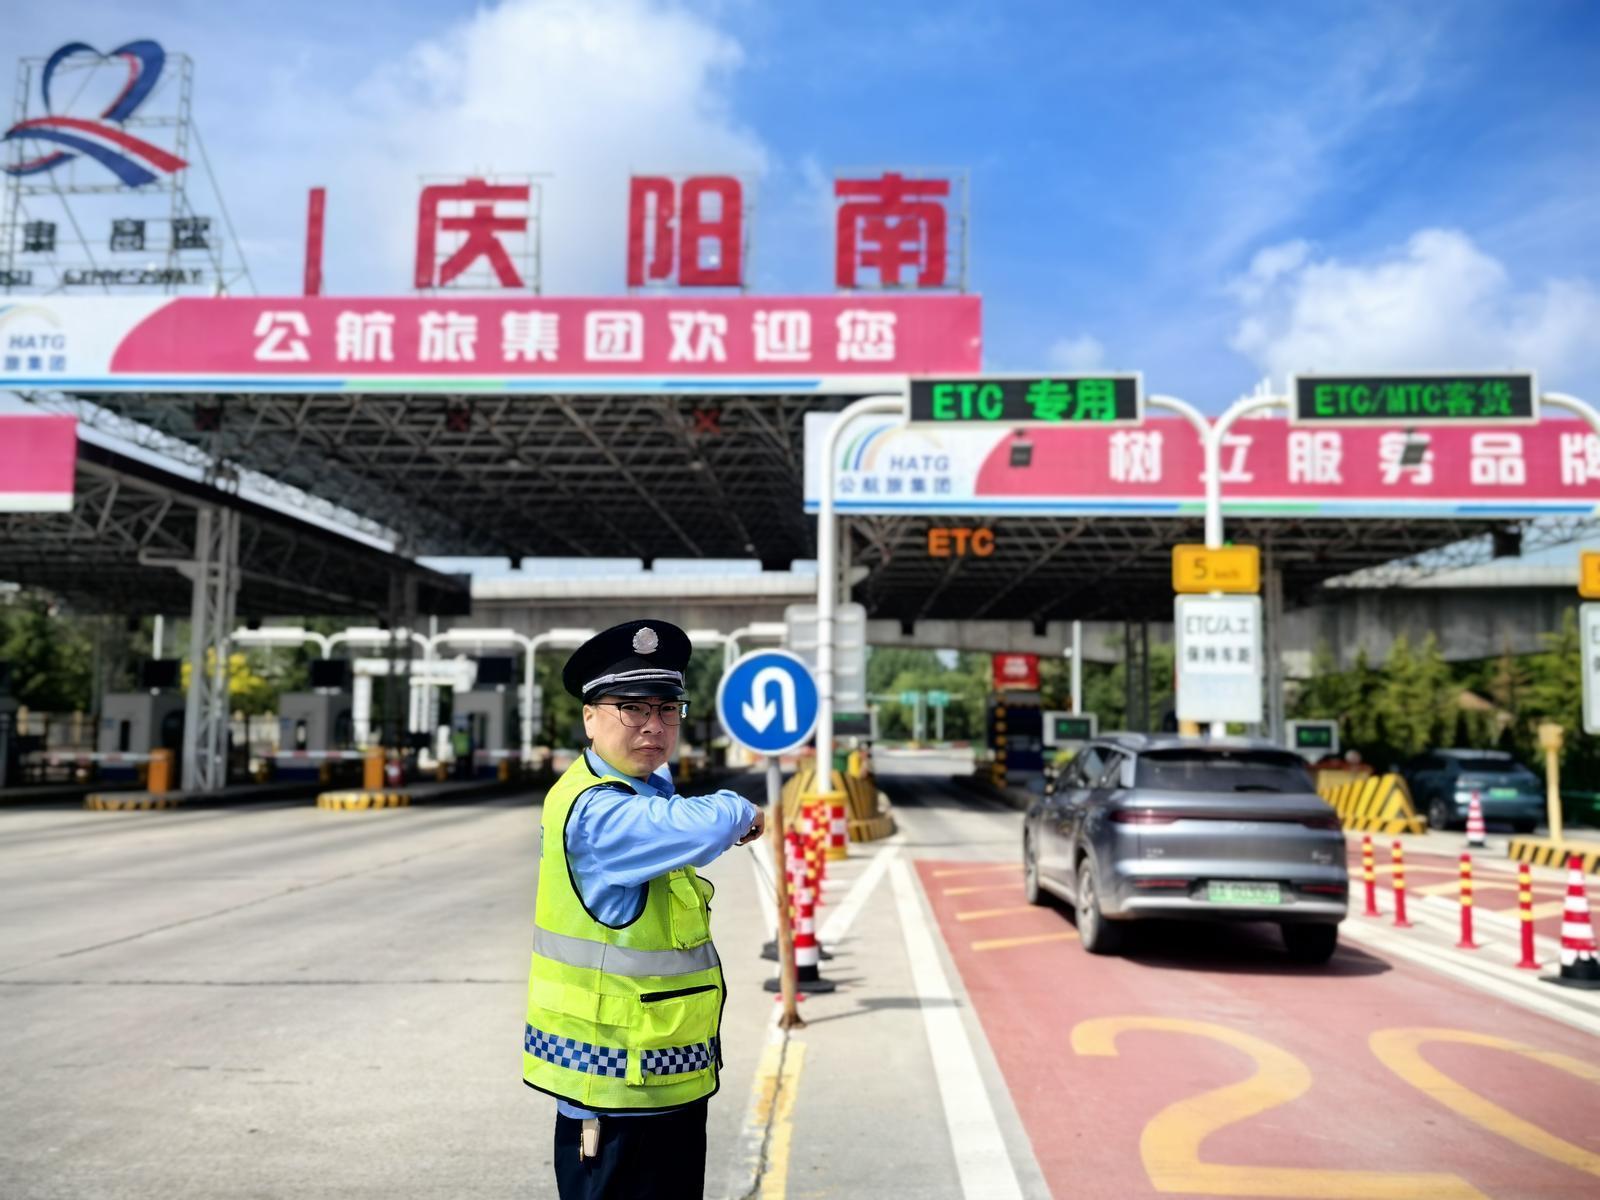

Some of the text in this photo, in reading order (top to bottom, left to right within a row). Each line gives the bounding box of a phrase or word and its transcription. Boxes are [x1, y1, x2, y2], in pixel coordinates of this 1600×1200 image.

[413, 172, 950, 288] 庆阳南
[9, 333, 66, 350] HATG
[253, 311, 898, 362] 公航旅集团欢迎您
[932, 377, 1116, 422] ETC 专用
[890, 455, 950, 471] HATG
[927, 529, 995, 557] ETC
[1193, 557, 1208, 580] 5
